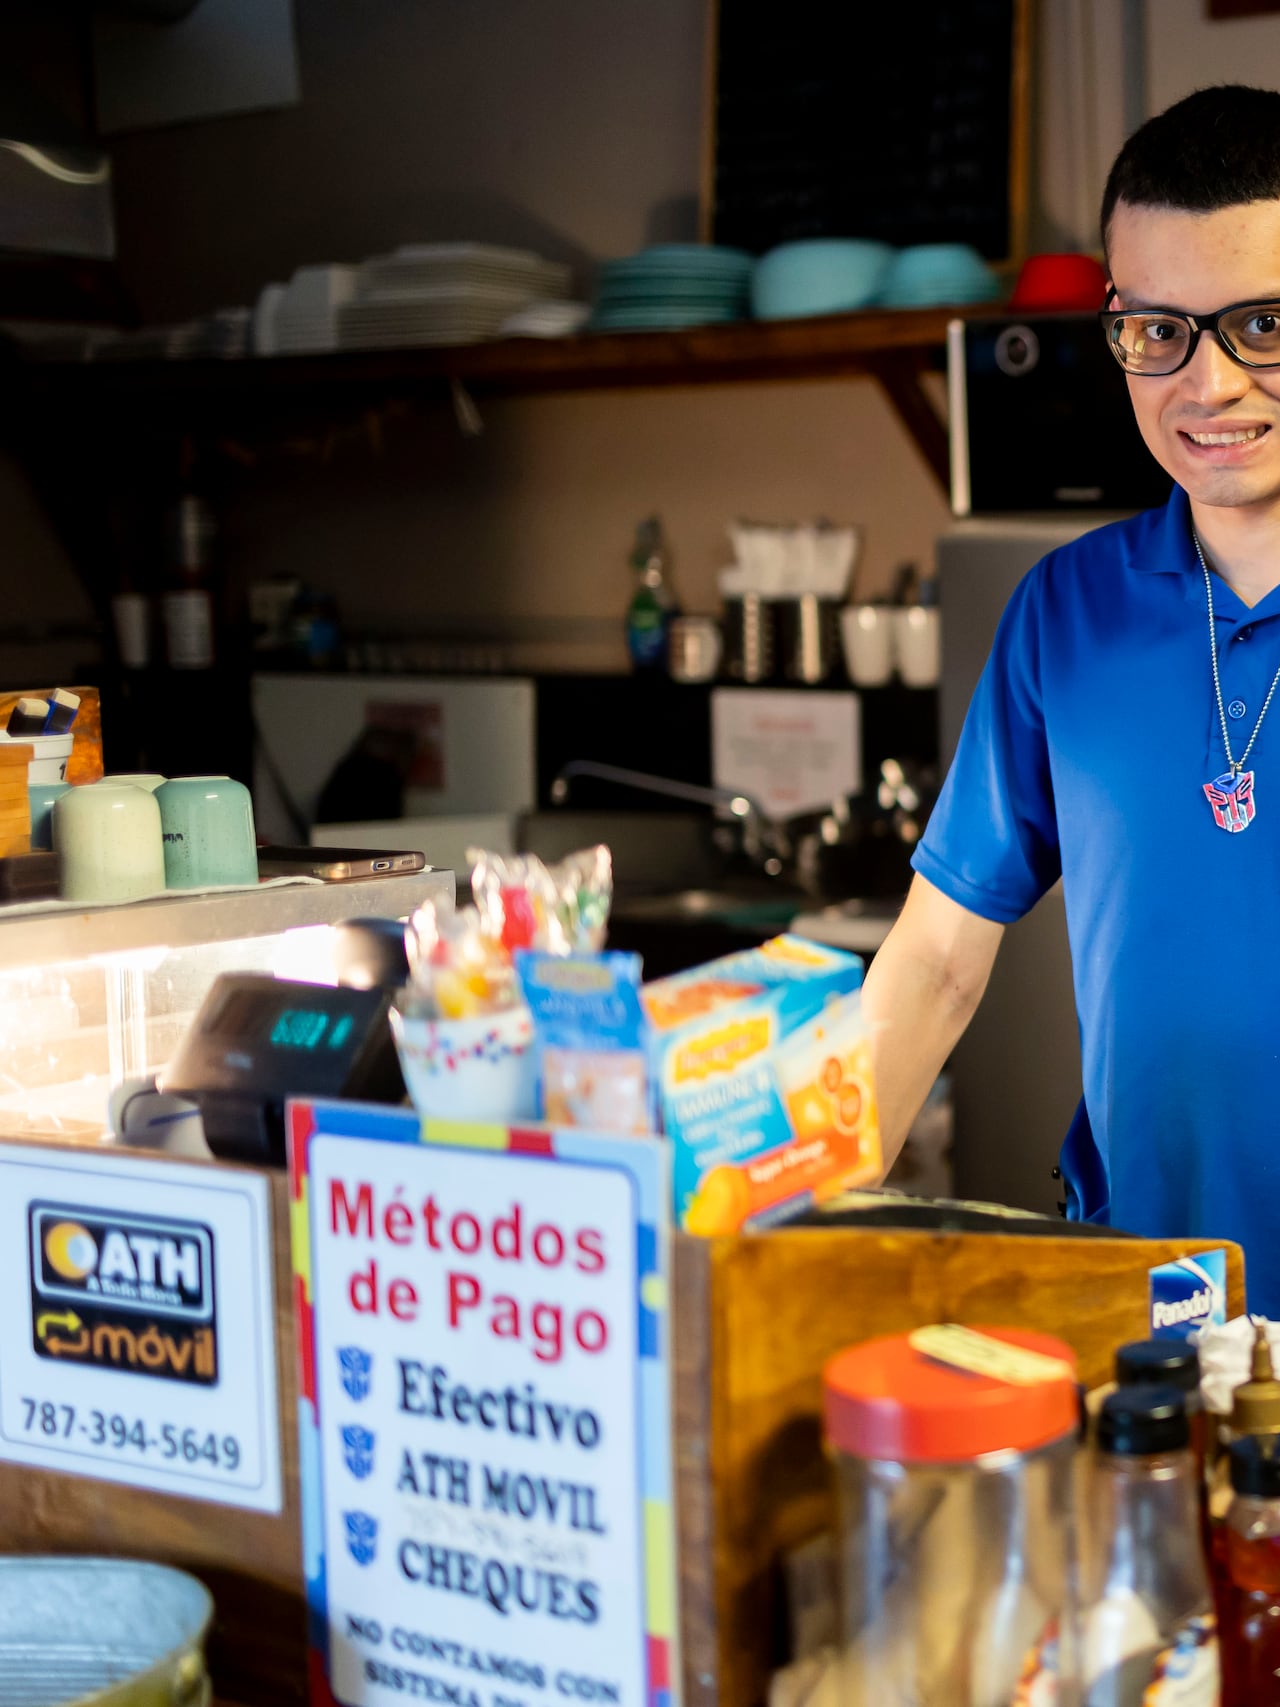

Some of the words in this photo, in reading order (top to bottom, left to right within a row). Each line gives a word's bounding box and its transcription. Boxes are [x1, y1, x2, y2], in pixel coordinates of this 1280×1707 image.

[101, 1230, 200, 1293] ATH
[329, 1178, 606, 1273] Métodos
[93, 1324, 215, 1376] móvil
[349, 1259, 418, 1321] de
[448, 1270, 607, 1363] Pago
[1152, 1286, 1211, 1329] Panadol
[21, 1397, 241, 1470] 787-394-5649
[397, 1358, 600, 1449] Efectivo
[397, 1447, 470, 1508] ATH
[482, 1464, 606, 1535] MOVIL
[398, 1538, 601, 1625] CHEQUES
[346, 1613, 383, 1646] NO
[390, 1627, 546, 1690] CONTAMOS
[555, 1671, 621, 1704] CON
